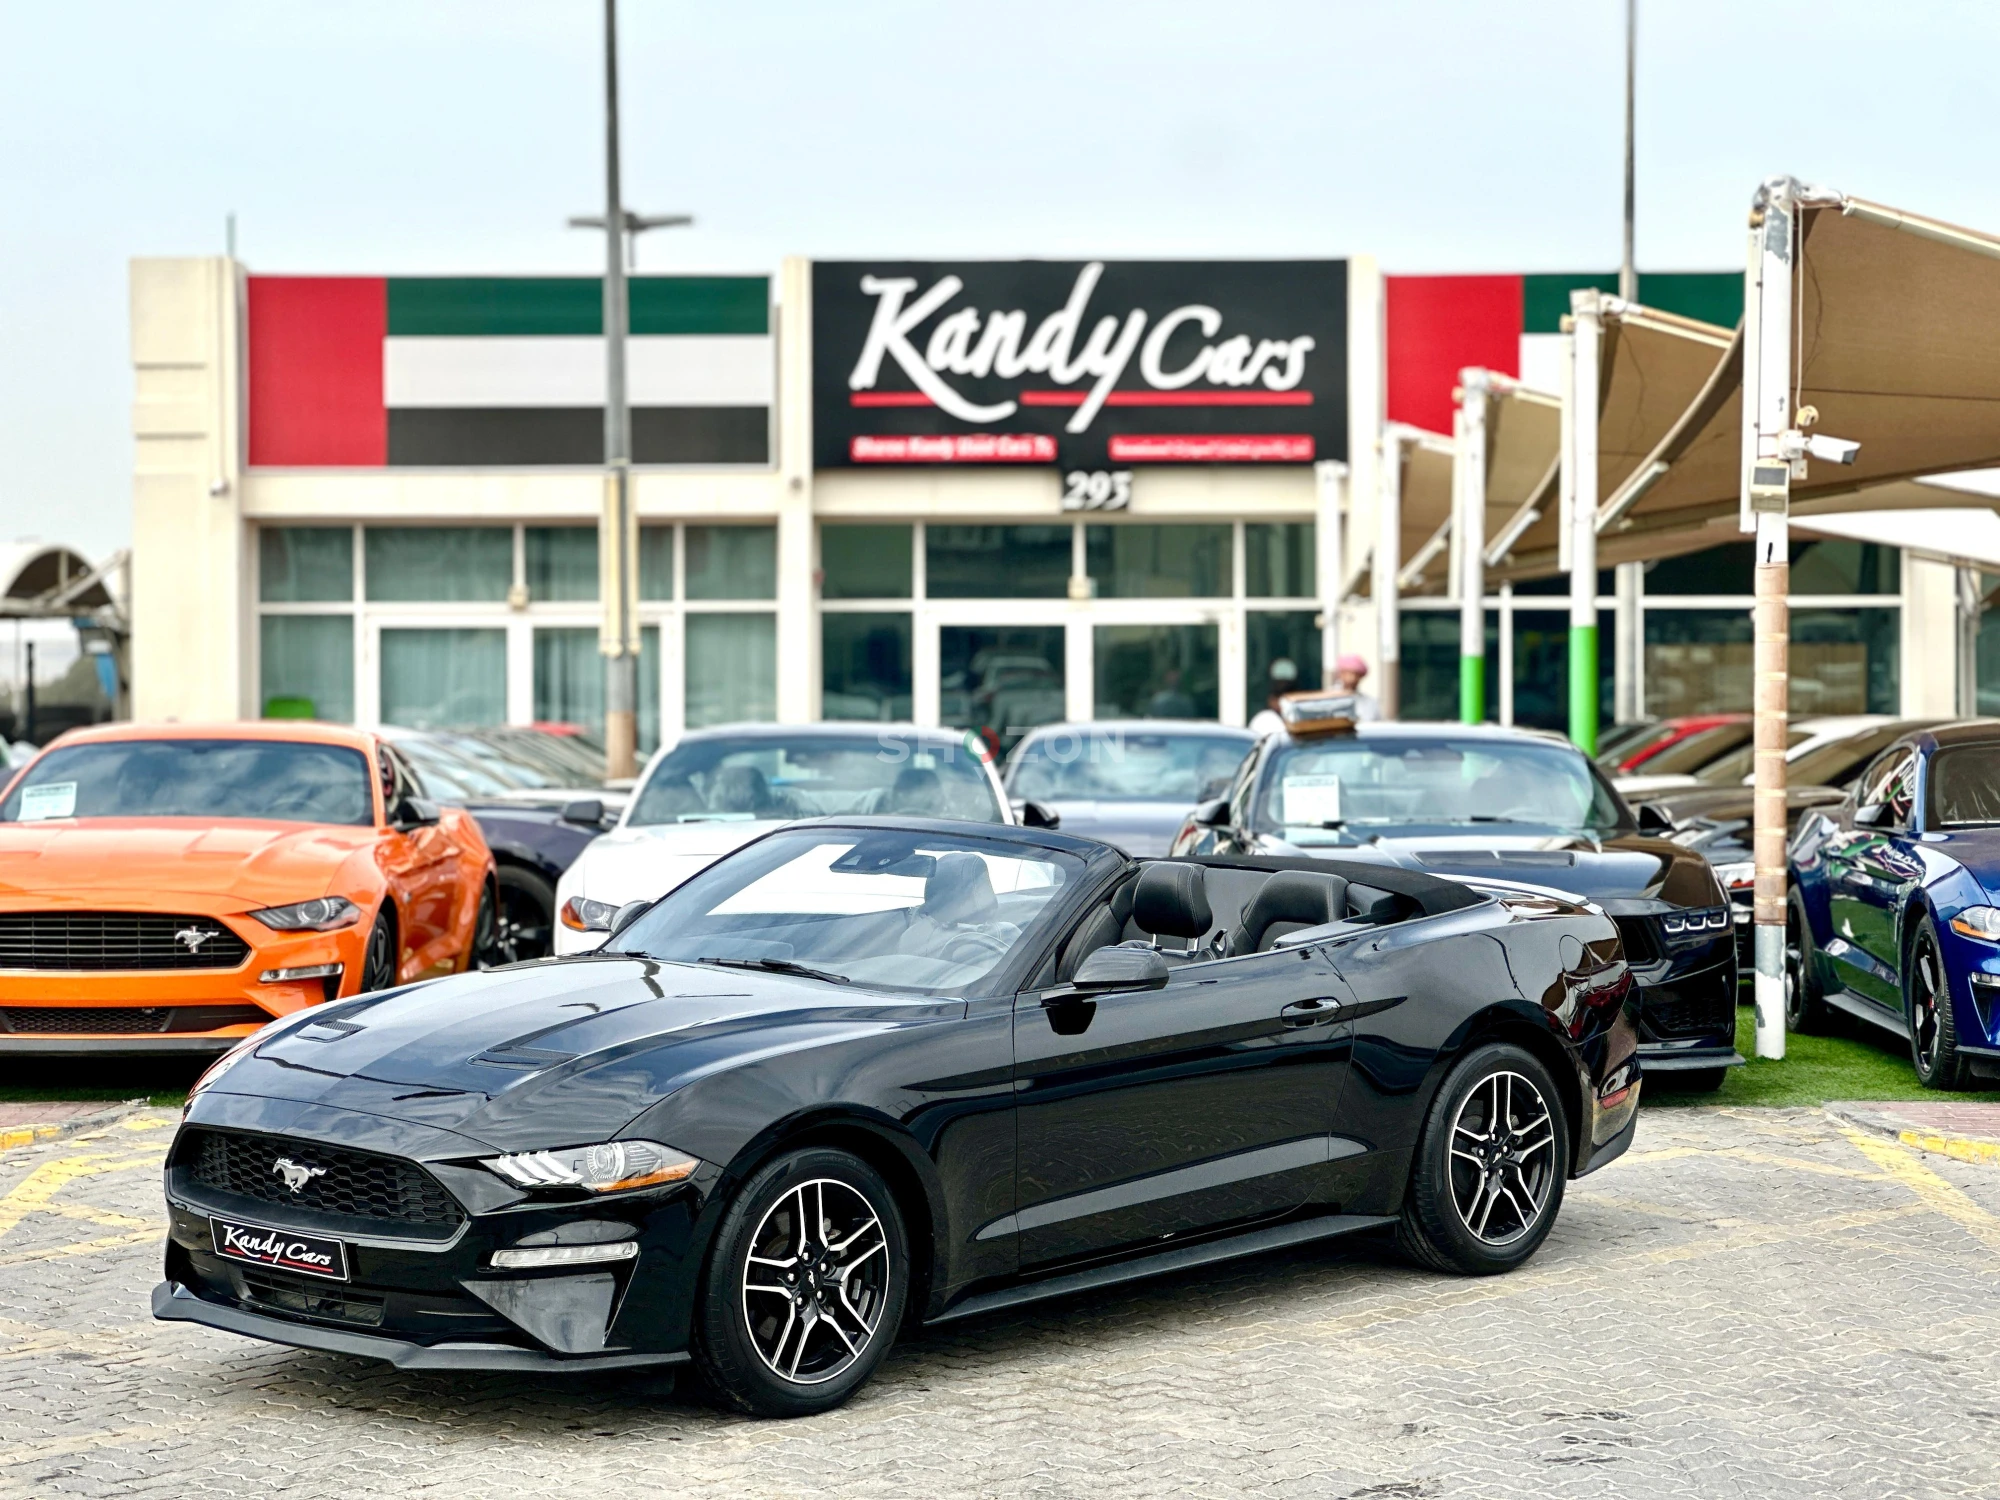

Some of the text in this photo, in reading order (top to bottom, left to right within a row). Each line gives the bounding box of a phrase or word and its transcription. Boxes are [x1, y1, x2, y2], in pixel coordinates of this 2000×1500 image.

[848, 262, 1315, 433] Kandy Cars
[222, 1224, 332, 1265] Kandy Cars
